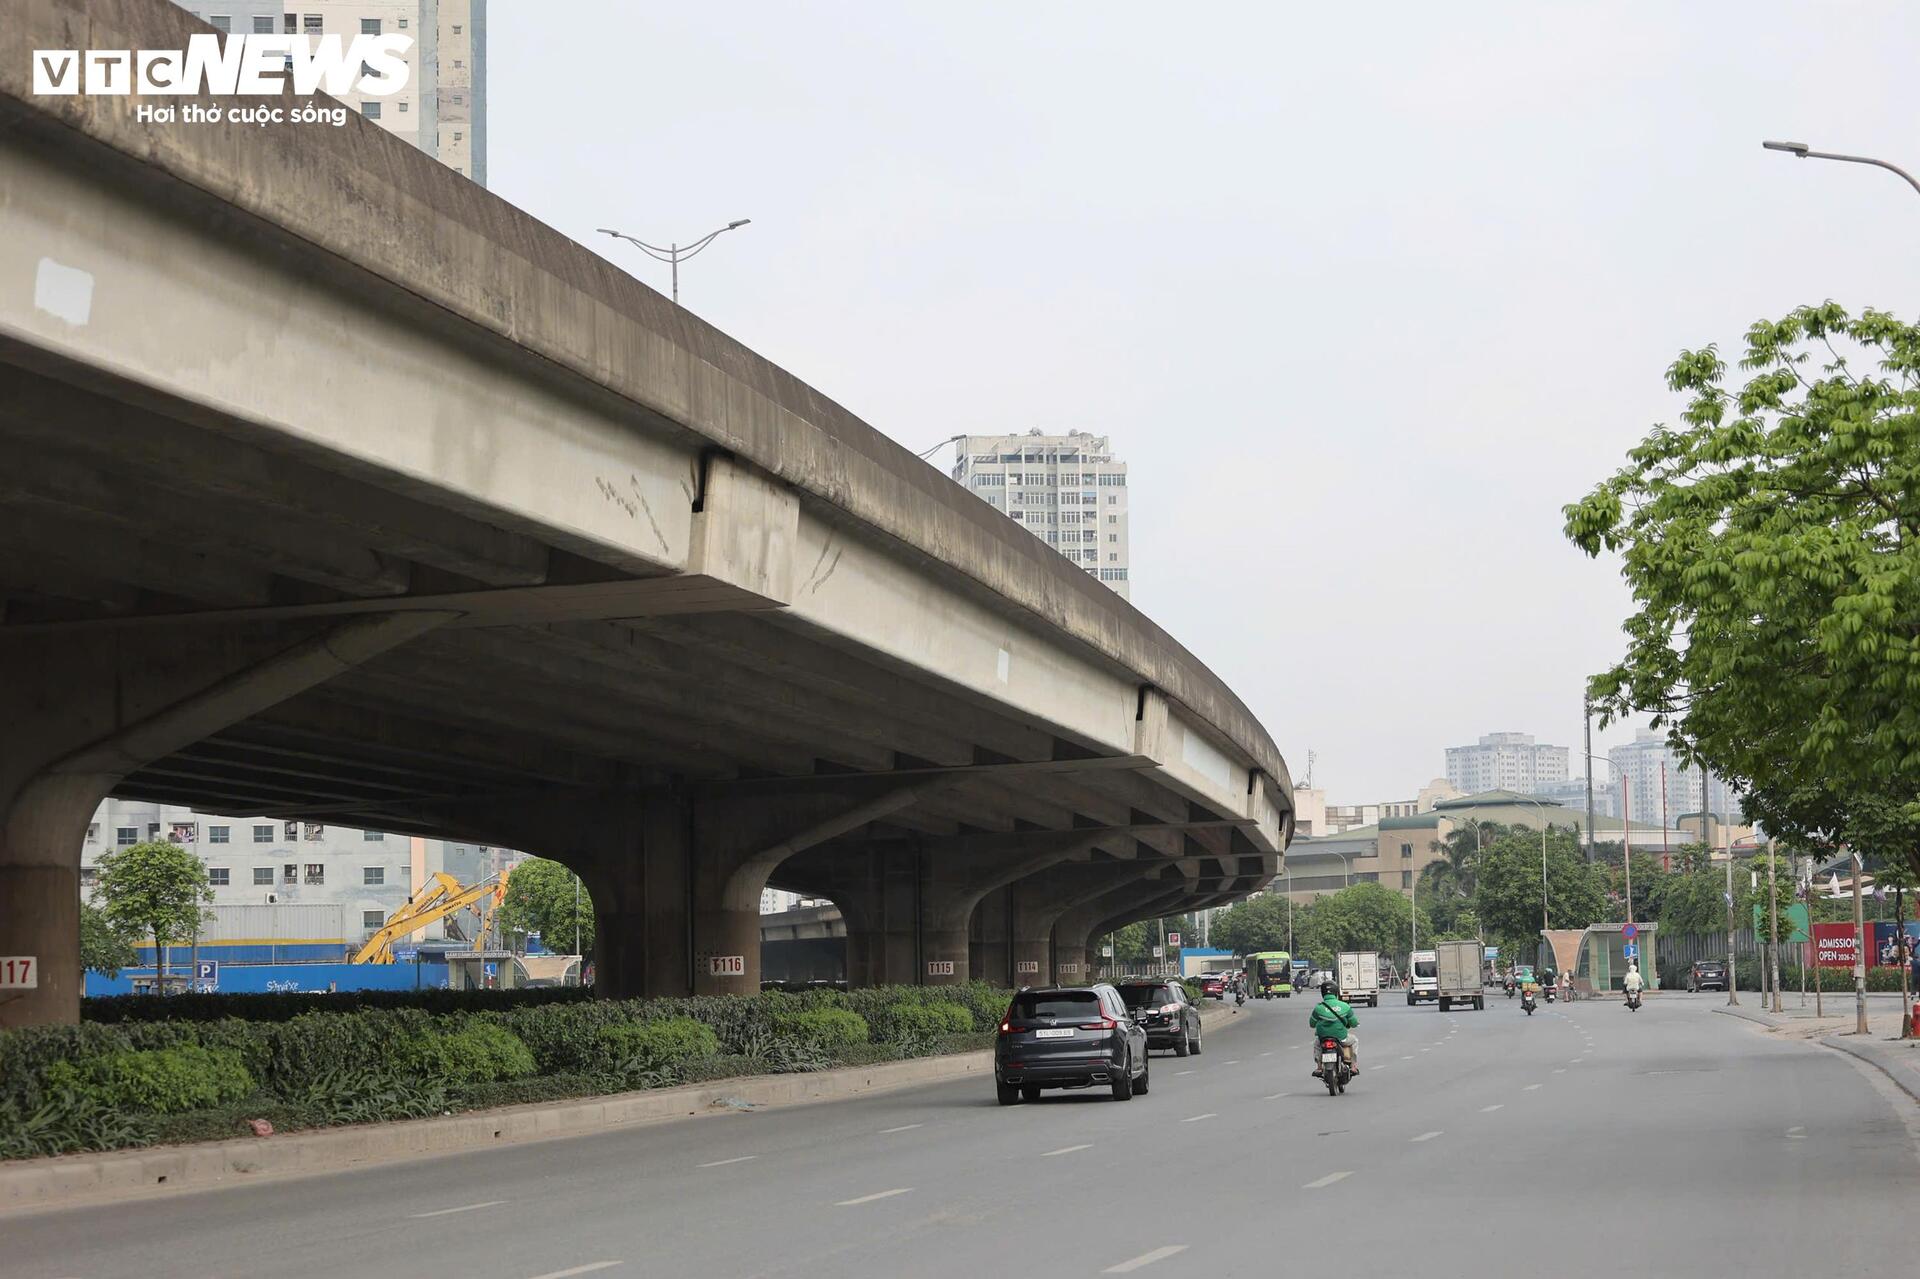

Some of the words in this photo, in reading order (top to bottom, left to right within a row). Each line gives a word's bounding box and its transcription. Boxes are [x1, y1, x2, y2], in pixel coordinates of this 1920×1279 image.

[1819, 951, 1837, 961] OPEN
[712, 958, 741, 972] T116
[929, 962, 951, 974] T115
[1018, 961, 1036, 972] T114
[200, 965, 211, 978] P
